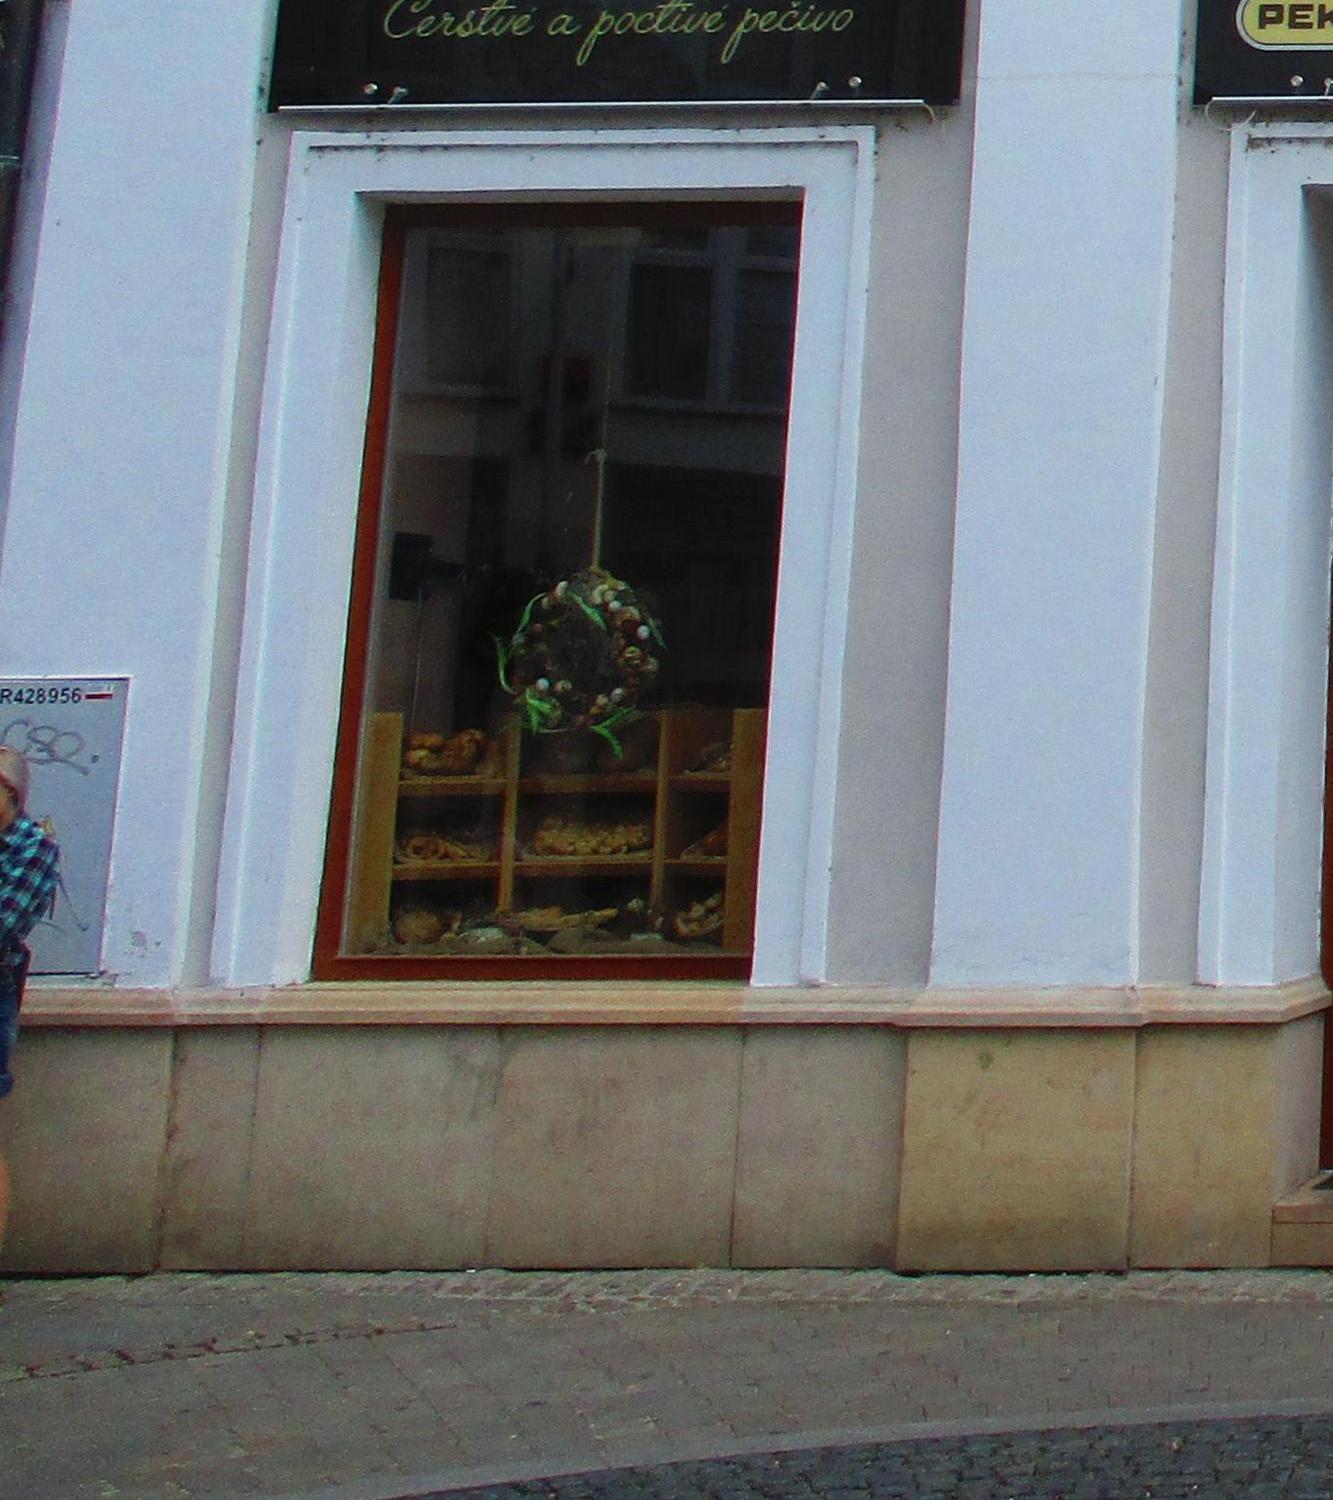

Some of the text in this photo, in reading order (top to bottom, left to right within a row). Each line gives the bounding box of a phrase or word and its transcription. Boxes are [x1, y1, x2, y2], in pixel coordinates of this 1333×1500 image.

[547, 13, 582, 36] a
[719, 0, 855, 64] pečivo
[0, 687, 82, 704] R428956
